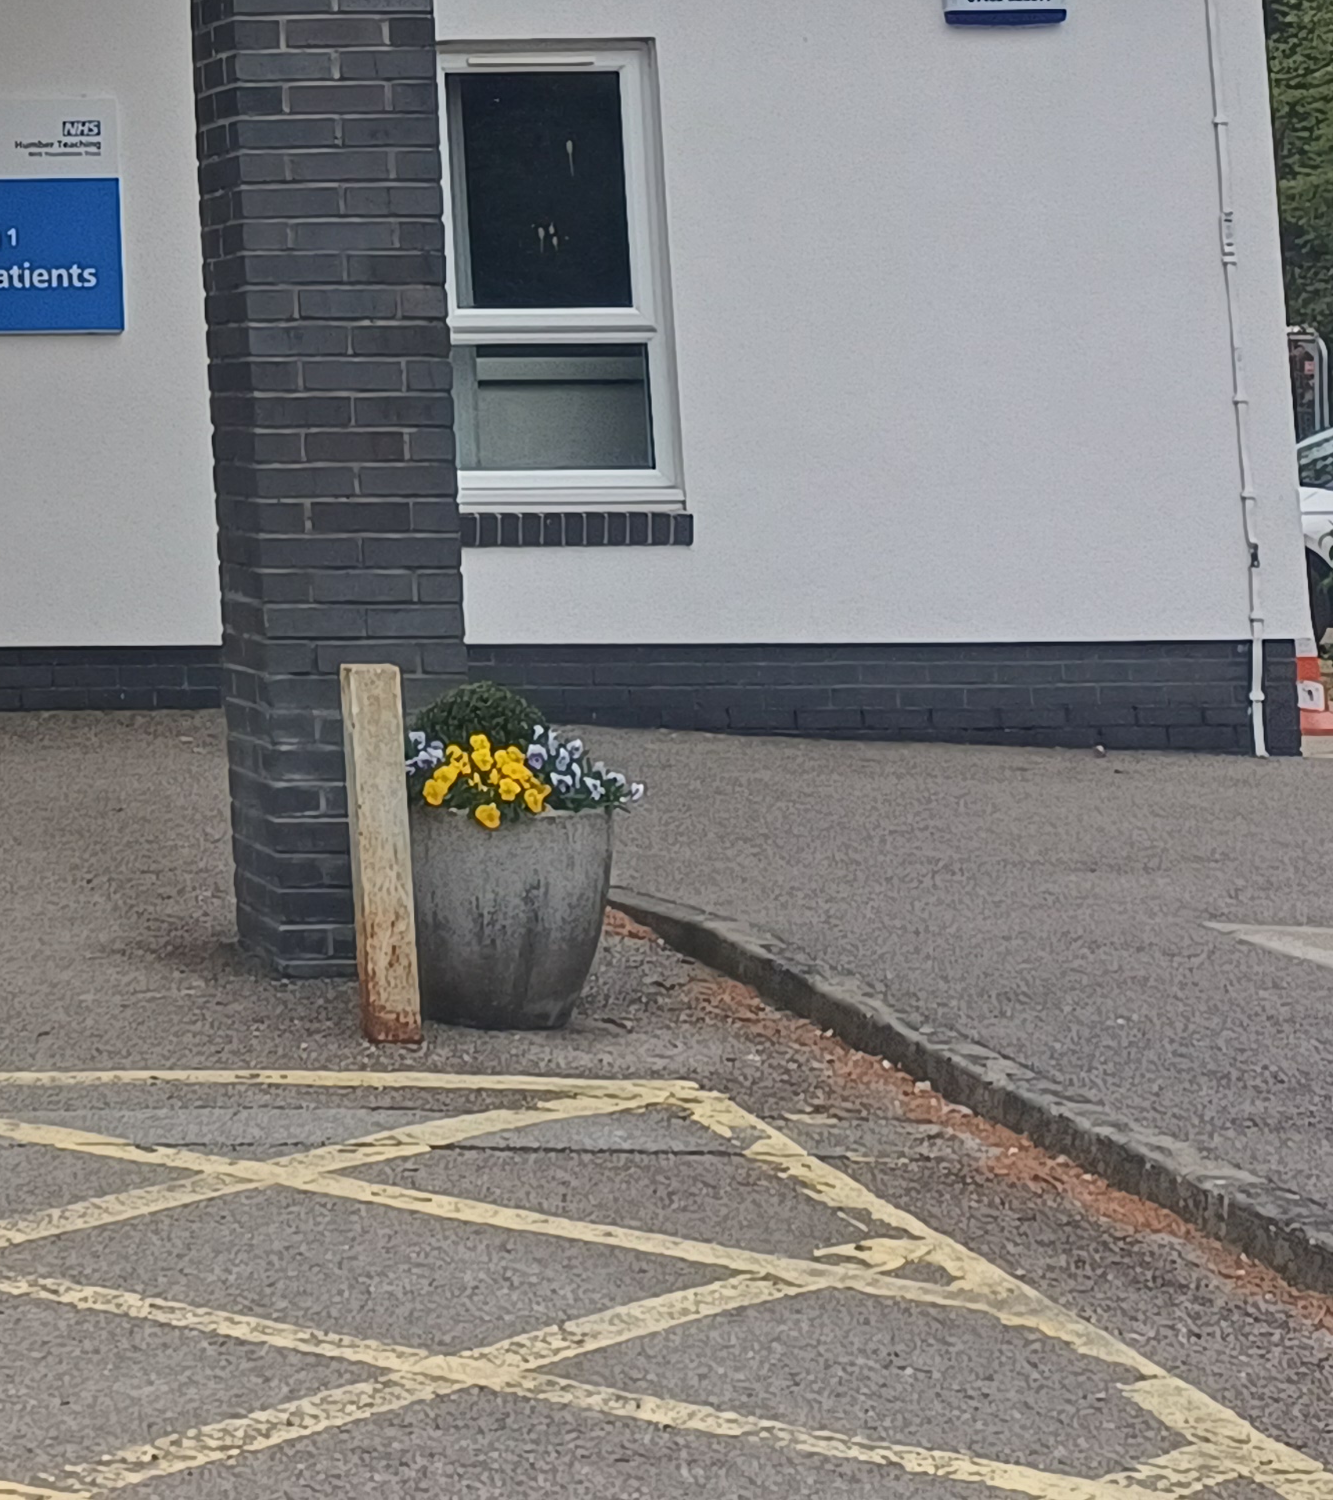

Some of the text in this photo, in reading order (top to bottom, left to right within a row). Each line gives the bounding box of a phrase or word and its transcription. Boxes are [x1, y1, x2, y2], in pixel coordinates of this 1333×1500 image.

[63, 120, 100, 136] NHS
[14, 139, 102, 150] Humber Teaching
[6, 227, 18, 247] 1
